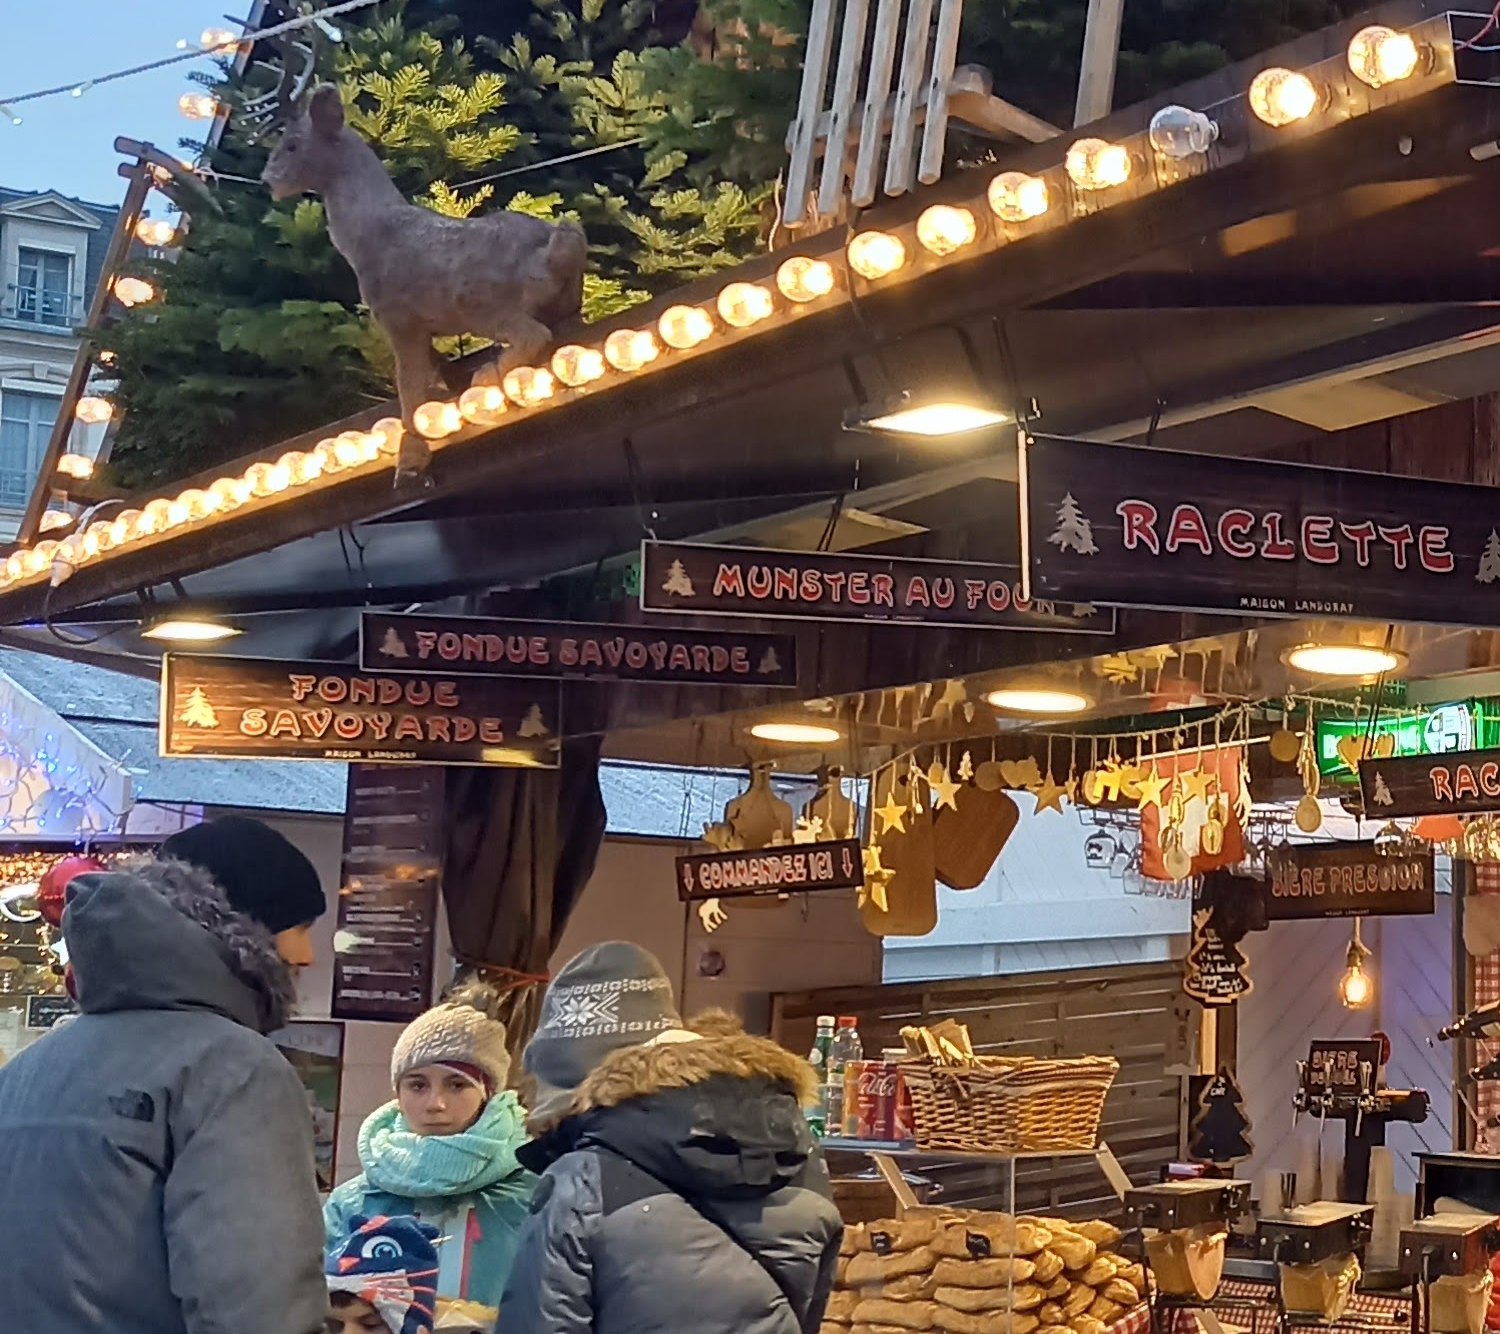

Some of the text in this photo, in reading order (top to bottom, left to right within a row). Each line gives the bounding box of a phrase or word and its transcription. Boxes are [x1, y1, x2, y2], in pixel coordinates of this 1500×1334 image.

[1117, 500, 1455, 572] RACLETTE
[713, 564, 895, 608] MUNSTER
[905, 576, 955, 609] AU
[1240, 597, 1285, 610] MAISON
[415, 630, 750, 675] FONDUE SAVOYARDE
[288, 673, 460, 707] FONDUE
[239, 708, 505, 744] SAVOYARDE
[699, 851, 834, 890] COMMANDEZ ICI
